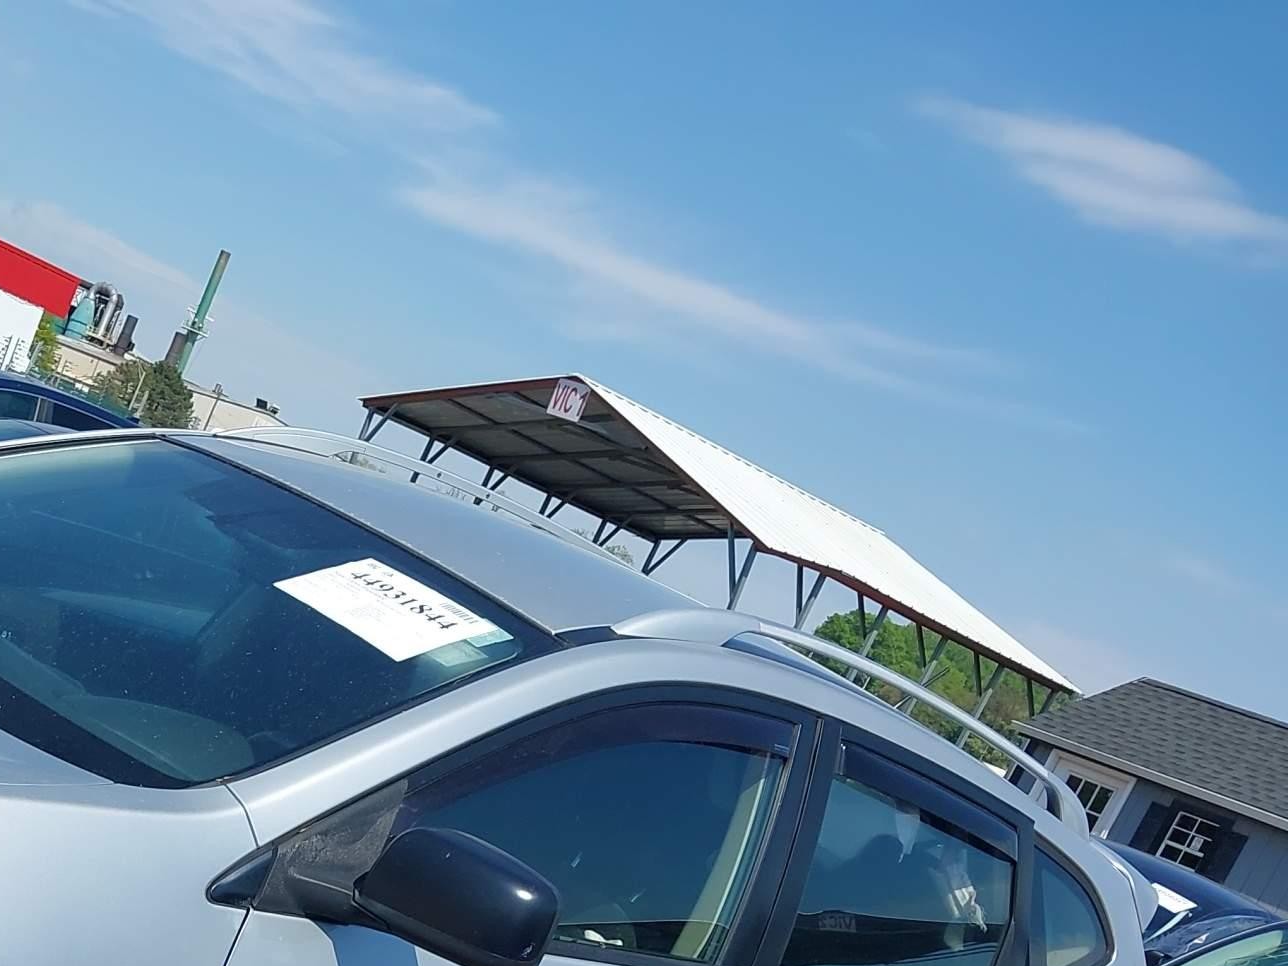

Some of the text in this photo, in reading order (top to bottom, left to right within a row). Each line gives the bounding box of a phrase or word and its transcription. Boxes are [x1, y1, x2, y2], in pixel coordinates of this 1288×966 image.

[551, 383, 589, 417] VIC 1
[350, 571, 459, 630] 44931844
